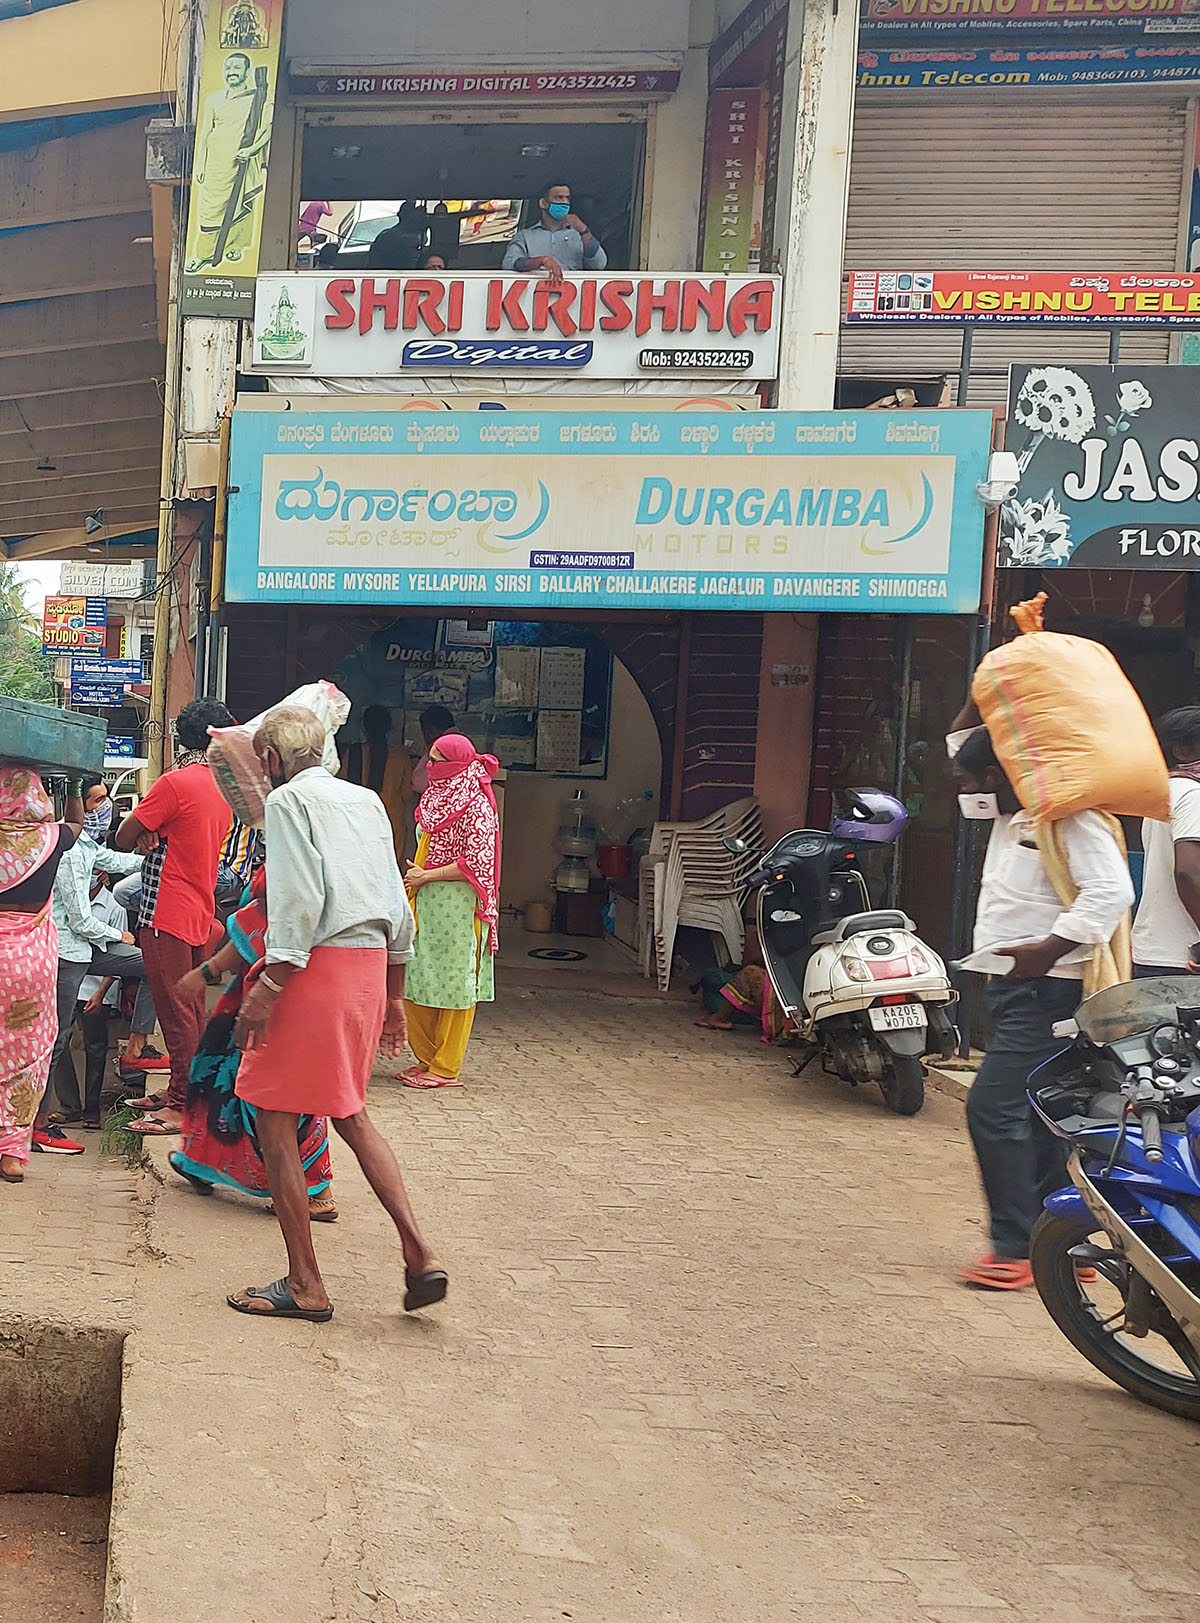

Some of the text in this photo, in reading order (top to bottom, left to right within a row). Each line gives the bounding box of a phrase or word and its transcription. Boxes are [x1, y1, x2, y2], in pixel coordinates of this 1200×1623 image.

[934, 21, 956, 30] types
[336, 75, 637, 93] SHRI KRISHNA DIGITAL 9243522425
[921, 70, 1030, 86] Telecom
[1037, 72, 1067, 82] Mob:
[728, 101, 748, 144] SHRI
[719, 158, 744, 236] KRISHNA
[324, 279, 775, 338] SHRI KRISHNA
[933, 291, 1093, 311] VISHNU
[405, 341, 590, 367] Digital
[641, 351, 752, 369] Mob: 9243522425
[330, 421, 394, 442] ಬೆಂಗಳೂರು
[406, 421, 460, 452] ಮೈಸೂರು
[479, 423, 540, 448] ಯಲ್ಲಾಪುರ
[629, 421, 660, 442] ಶಿರಸಿ
[680, 421, 719, 454] ಬಳ್ಳಾರಿ
[795, 420, 858, 443] ದಾವಣಗೆರೆ
[885, 420, 941, 453] ಶಿವಮೊಗ್ಗ
[275, 465, 519, 522] ದುರ್ಗಾಂಬಾ
[635, 477, 889, 527] DURGAMBA
[635, 534, 789, 555] MOTORS
[533, 553, 631, 568] GSTIN: 29AADFD9700B1ZR
[110, 577, 138, 587] COIN
[257, 571, 948, 599] BANGALORE MYSORE YELLAPURA SIRSI BALLARY CHALLAKERE JAGALUR DAVANGERE SHIMOGGA
[44, 629, 79, 644] STUDIO
